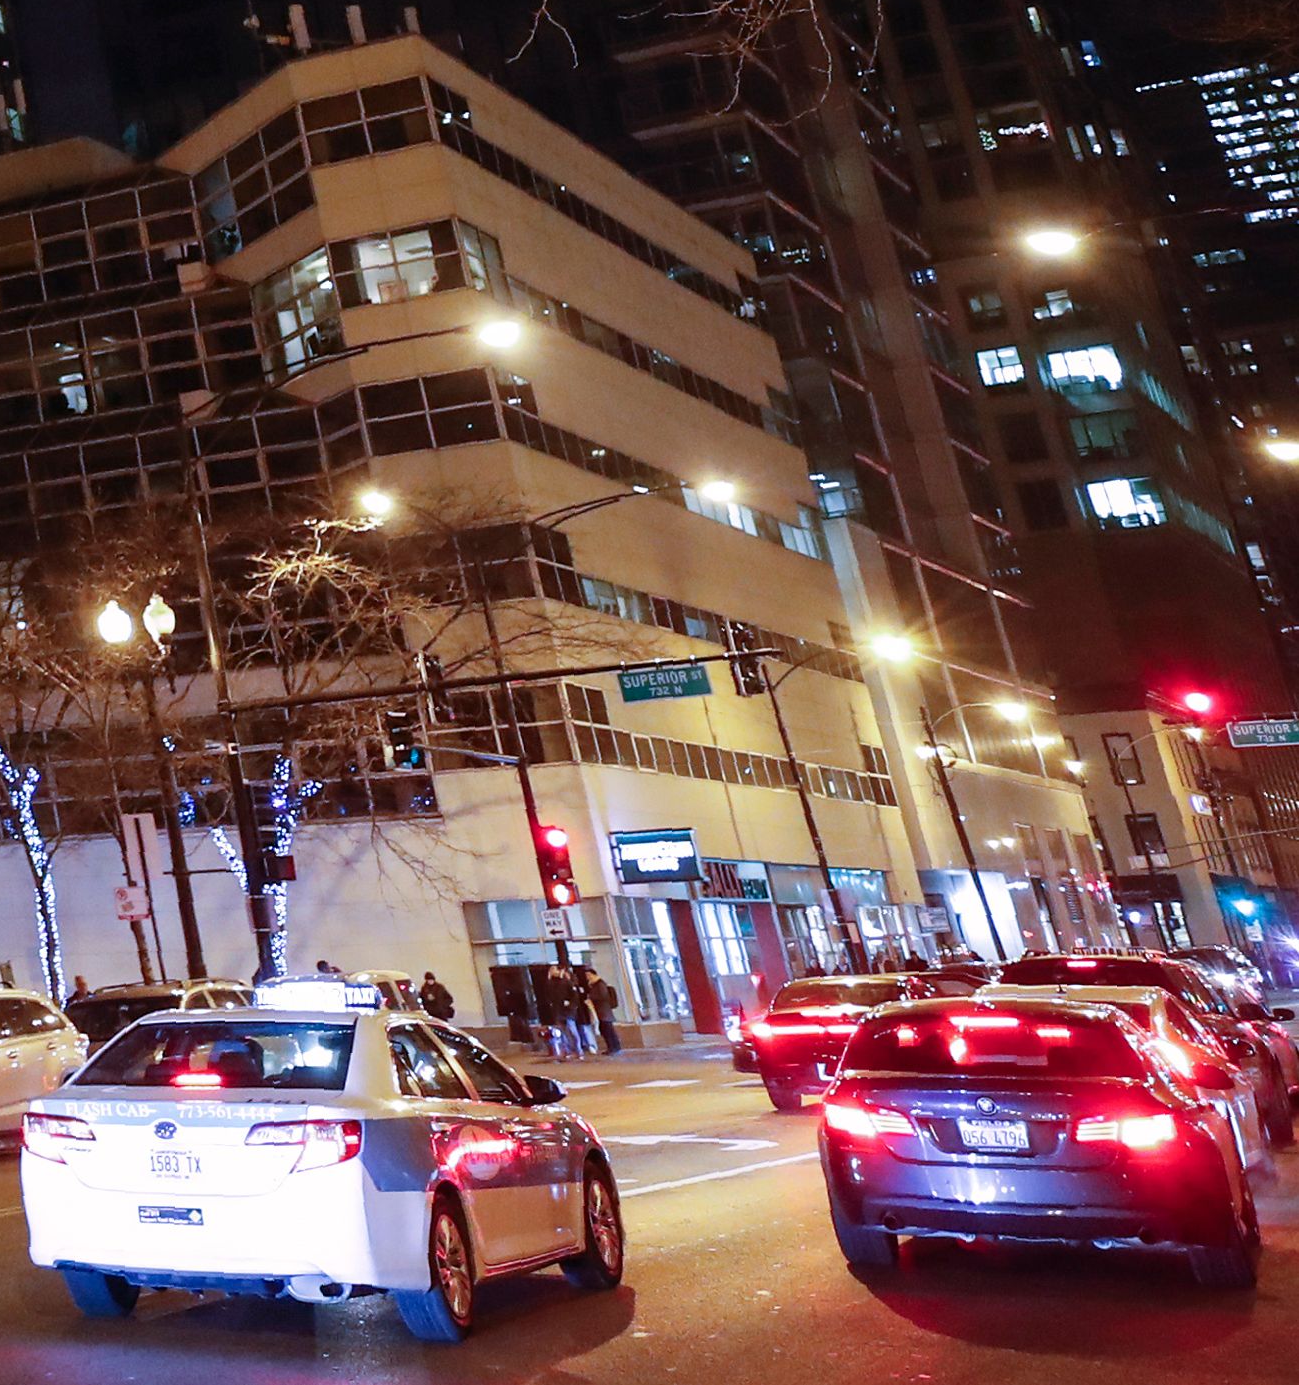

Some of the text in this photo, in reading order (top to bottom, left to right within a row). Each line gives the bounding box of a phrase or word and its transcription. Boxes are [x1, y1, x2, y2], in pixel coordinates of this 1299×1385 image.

[622, 670, 703, 688] SUPERIOR ST
[649, 685, 684, 697] 732 N
[1233, 723, 1299, 736] SUPERIOR S
[1256, 734, 1287, 743] 732 N
[545, 919, 562, 927] WAY
[344, 986, 376, 1005] TAXI
[65, 1102, 113, 1117] FLASH
[150, 1155, 202, 1174] 1583 TX
